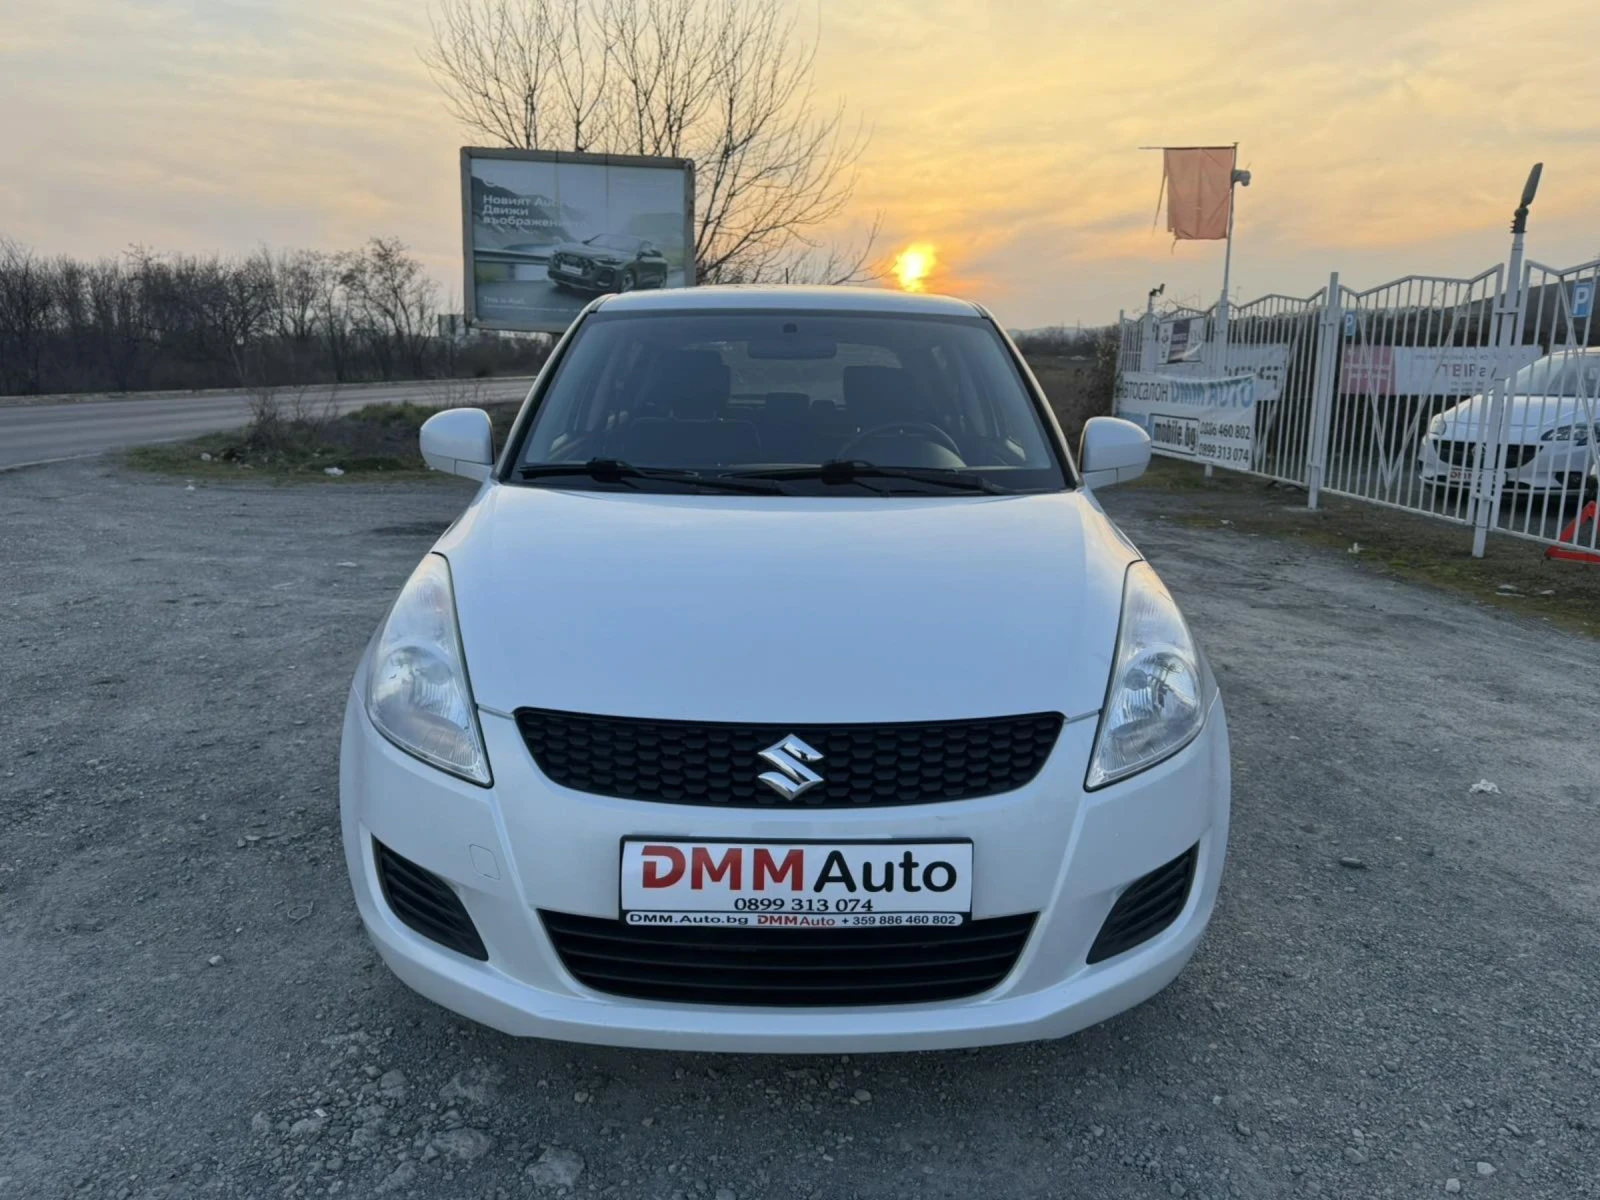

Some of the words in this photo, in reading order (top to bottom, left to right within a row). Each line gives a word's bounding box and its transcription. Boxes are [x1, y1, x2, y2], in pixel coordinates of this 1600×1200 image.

[483, 194, 530, 206] Новият
[482, 204, 529, 216] Движи
[483, 215, 586, 228] въображени
[1573, 287, 1589, 315] P
[1219, 424, 1234, 438] 460
[1235, 425, 1250, 440] 802
[1217, 445, 1231, 460] 313
[1233, 448, 1249, 463] 074
[734, 898, 785, 911] 0899
[791, 898, 829, 911] 313
[835, 899, 874, 912] 074
[629, 913, 749, 925] DMM.Auto.bg
[879, 916, 903, 925] 886
[905, 915, 929, 924] 460
[932, 915, 956, 925] 802
